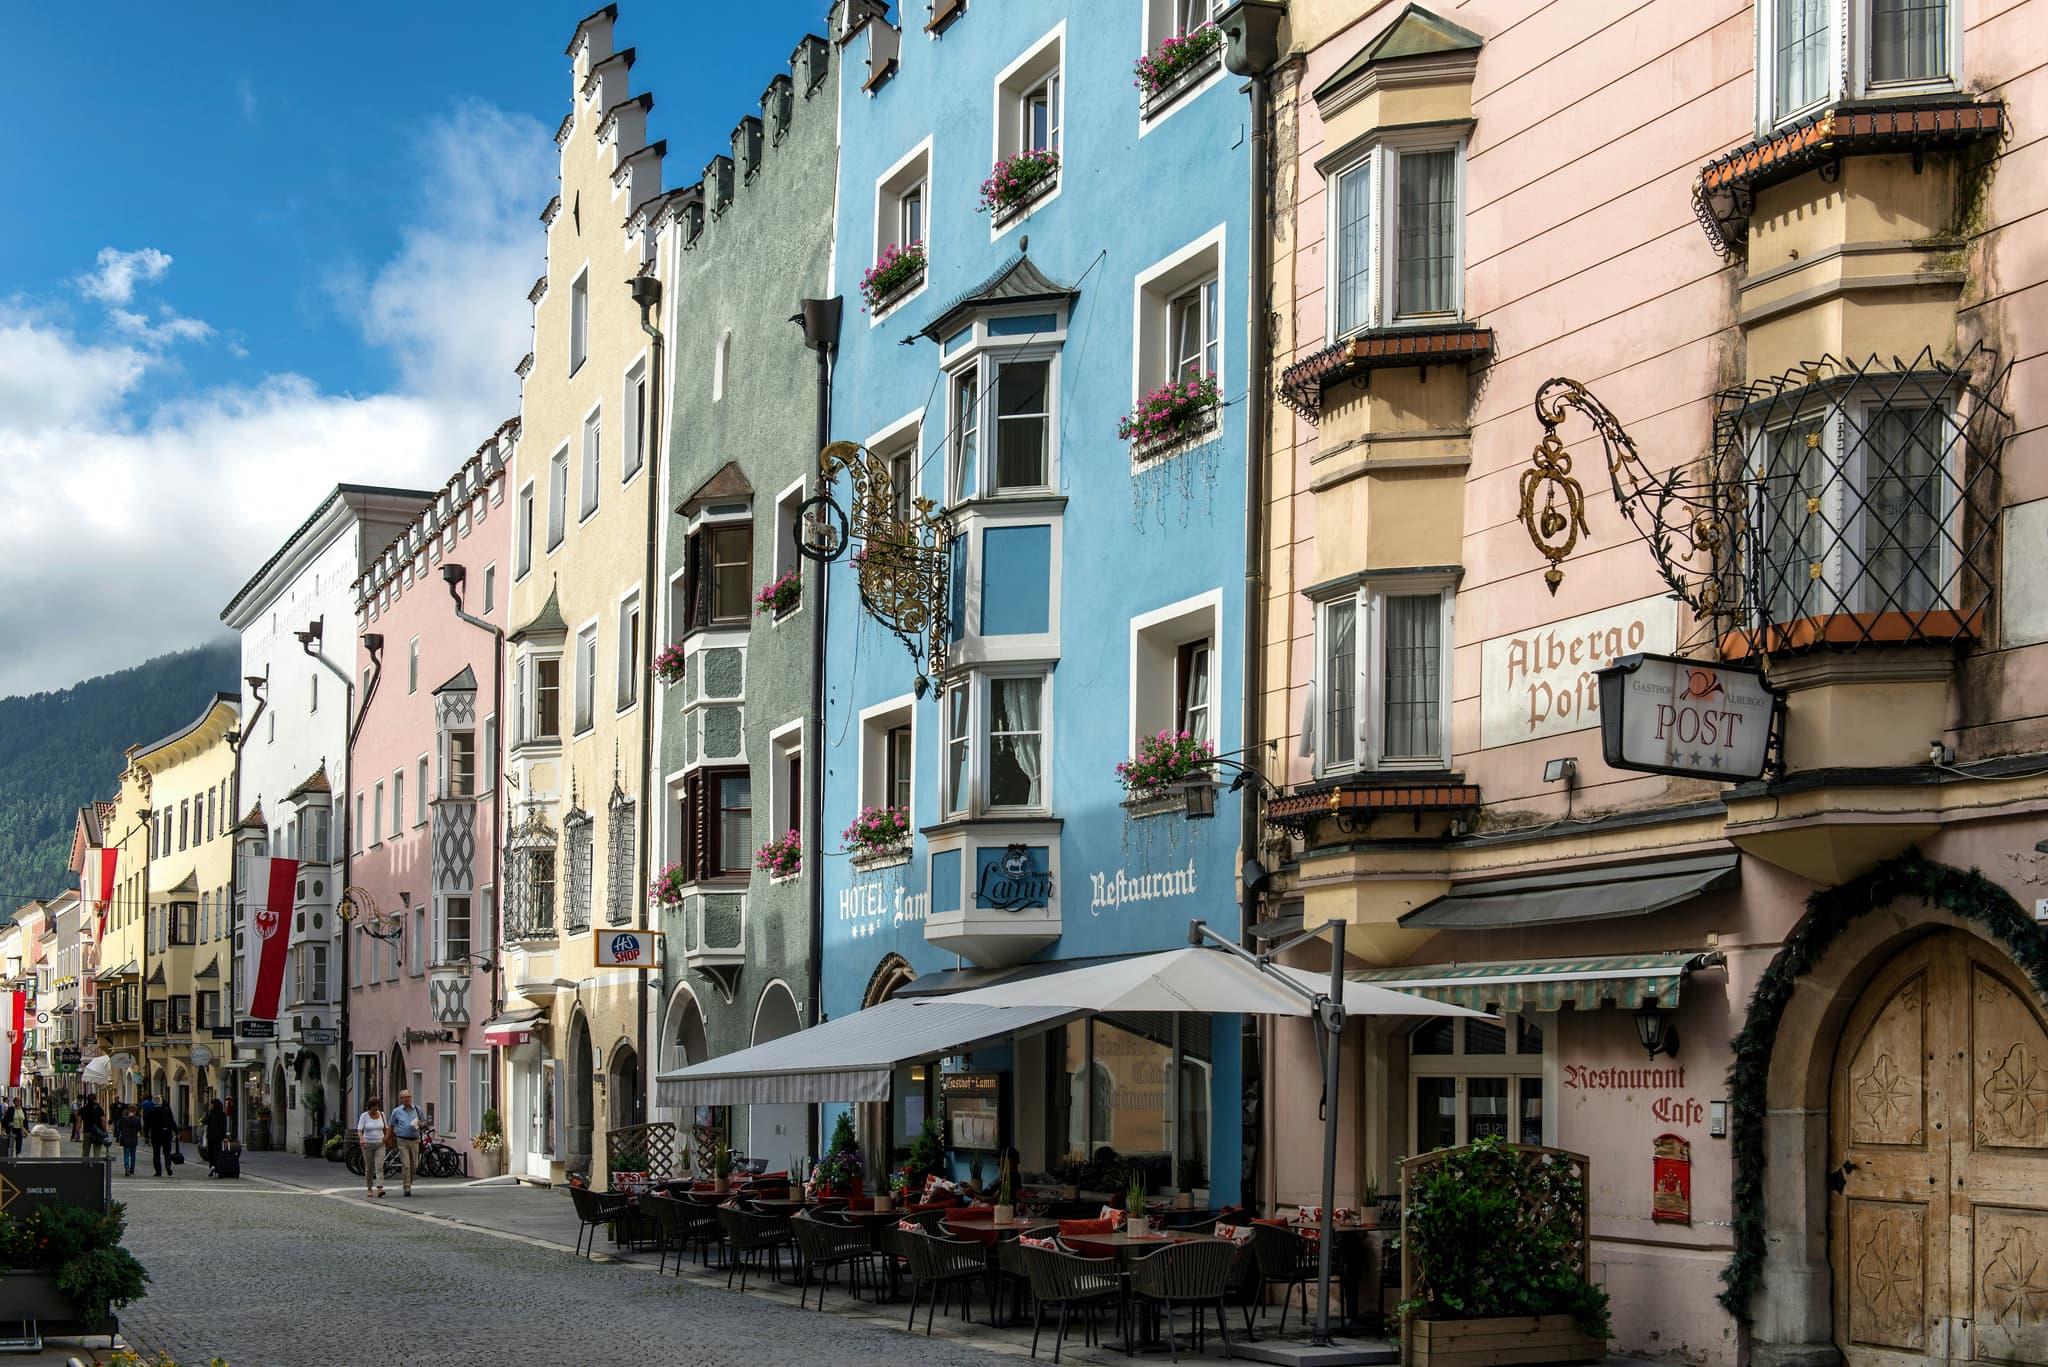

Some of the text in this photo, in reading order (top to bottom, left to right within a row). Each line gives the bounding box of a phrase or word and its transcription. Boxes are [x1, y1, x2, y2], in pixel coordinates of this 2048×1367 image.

[1506, 620, 1645, 691] Albergo
[1654, 703, 1743, 748] POST
[839, 882, 888, 921] HOTEL
[971, 861, 1054, 912] Lamm
[614, 949, 640, 963] SHOP
[1563, 1064, 1686, 1090] Restaurant
[1651, 1096, 1704, 1128] Cafe
